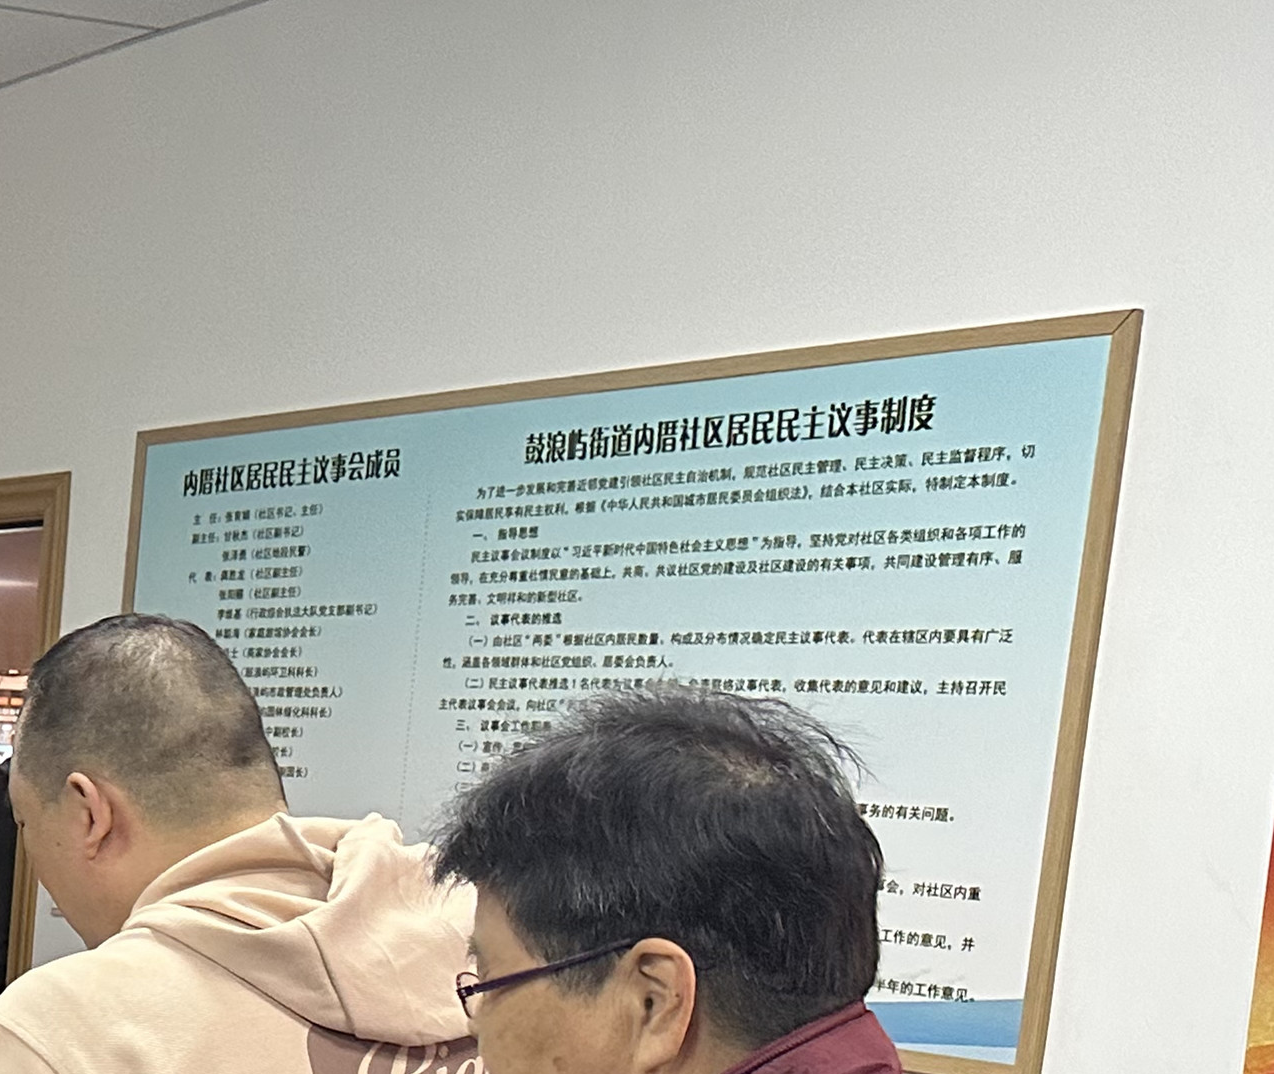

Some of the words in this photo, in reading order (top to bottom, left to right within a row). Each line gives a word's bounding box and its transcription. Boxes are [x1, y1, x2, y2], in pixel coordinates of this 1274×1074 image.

[524, 393, 937, 465] 鼓浪屿街道内厝社区居民民主议事制度
[182, 448, 402, 498] 内厝社区居民民主议事会成员
